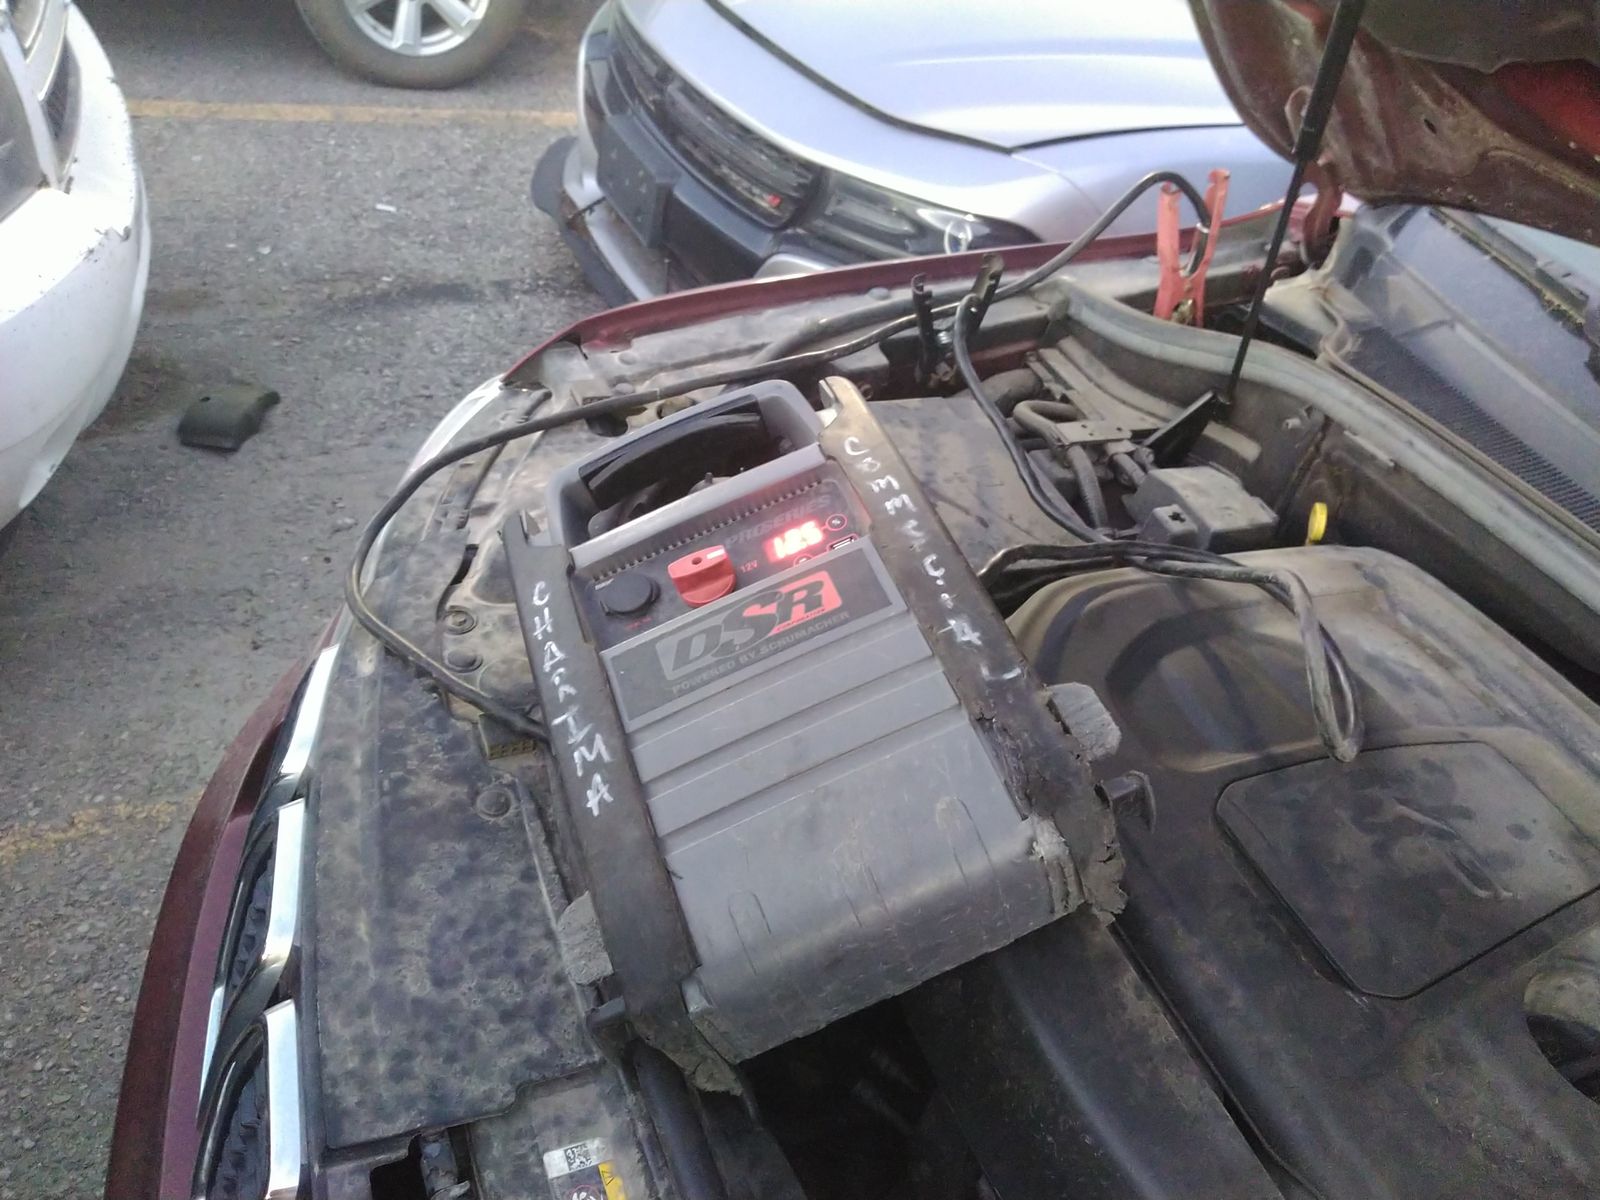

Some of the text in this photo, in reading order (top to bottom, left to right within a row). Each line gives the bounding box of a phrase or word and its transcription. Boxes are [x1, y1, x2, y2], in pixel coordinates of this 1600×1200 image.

[739, 560, 759, 574] 12V
[671, 577, 827, 672] DSR
[671, 660, 736, 696] POWERED
[738, 650, 756, 666] BY
[759, 611, 851, 656] SCHUMACHER
